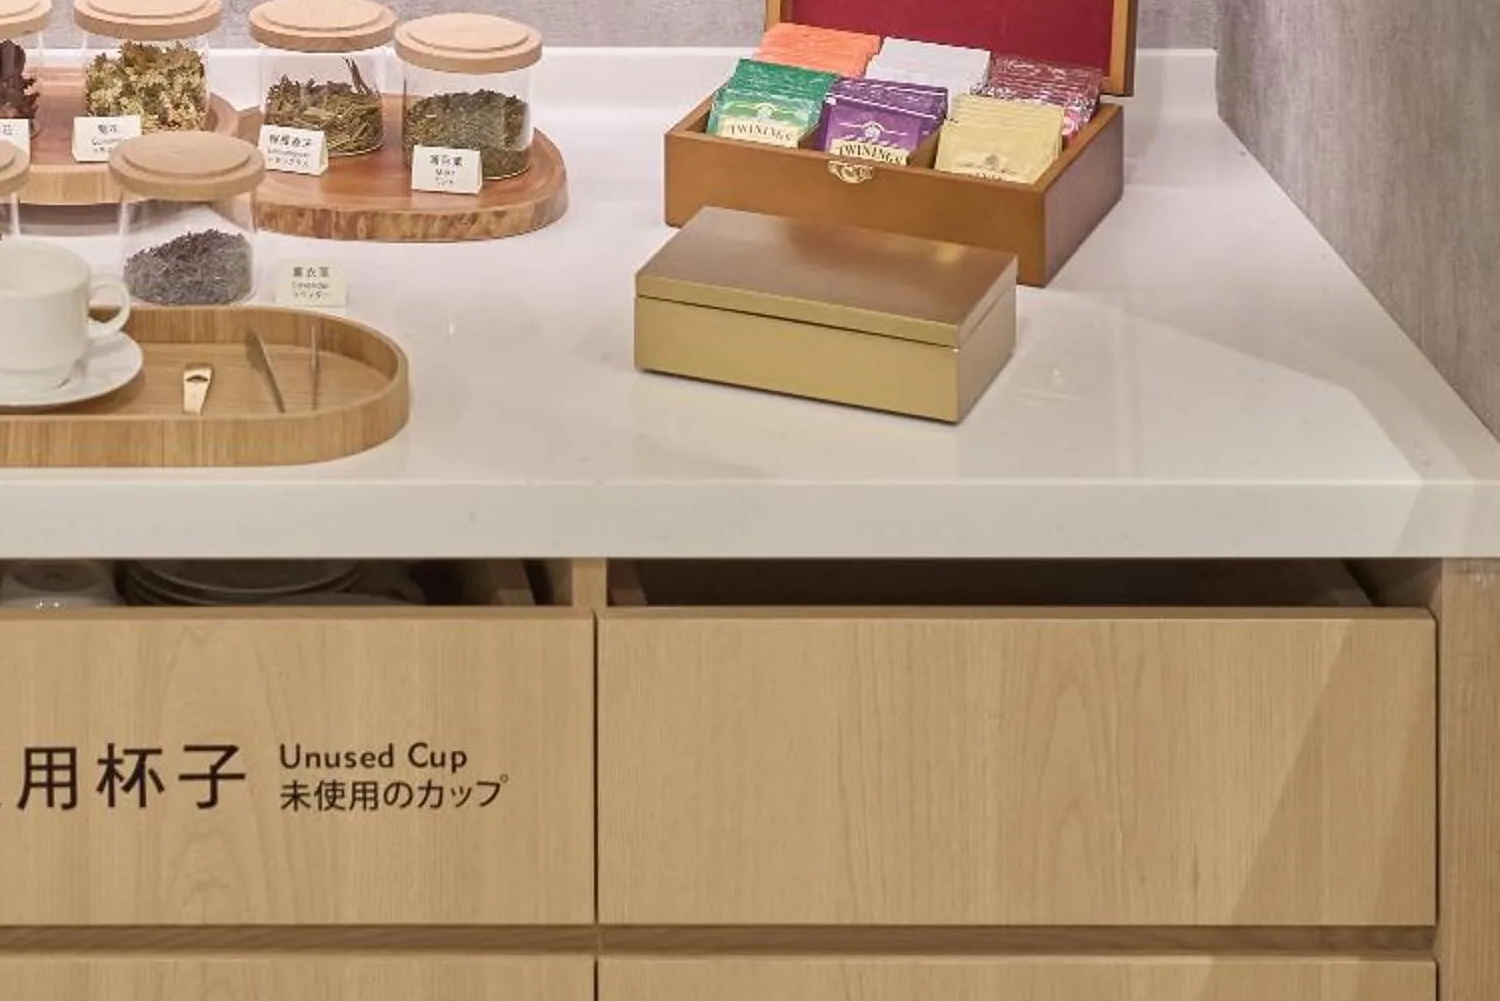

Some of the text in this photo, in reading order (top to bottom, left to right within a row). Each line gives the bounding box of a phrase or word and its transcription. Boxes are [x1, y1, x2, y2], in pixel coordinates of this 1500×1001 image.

[280, 742, 467, 773] Unused Cup
[280, 774, 508, 812] 未使用のカップ
